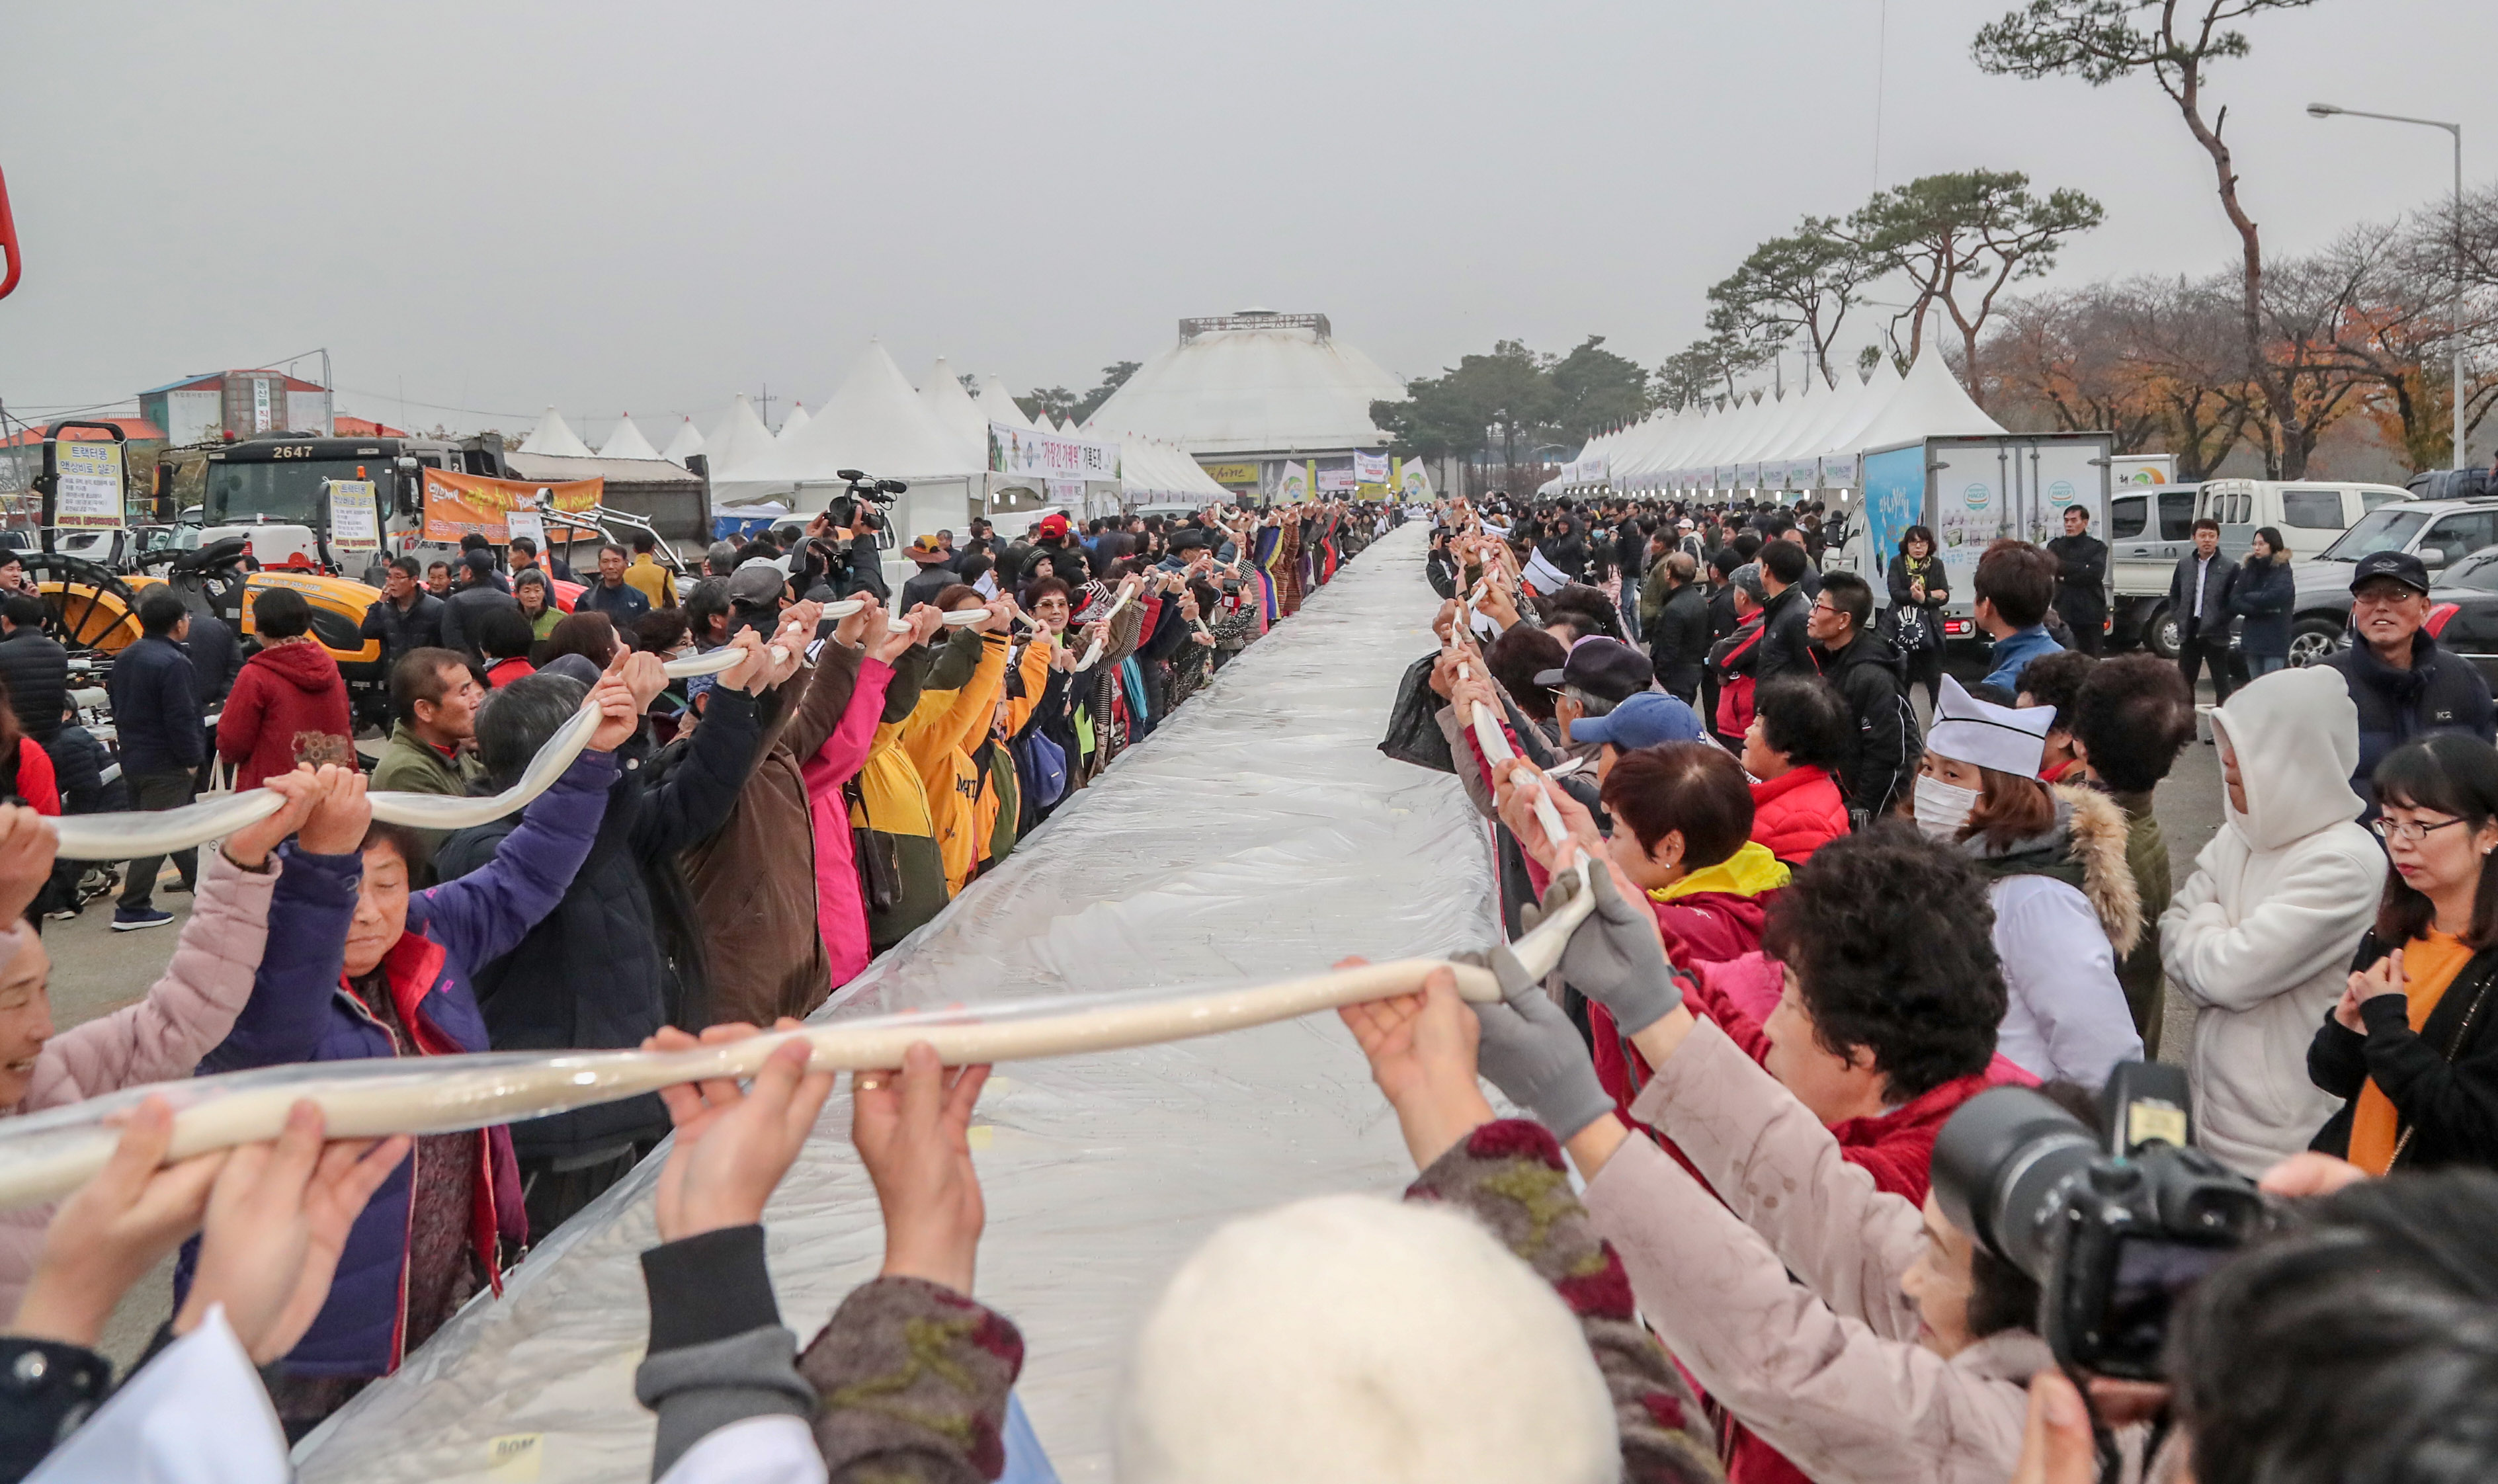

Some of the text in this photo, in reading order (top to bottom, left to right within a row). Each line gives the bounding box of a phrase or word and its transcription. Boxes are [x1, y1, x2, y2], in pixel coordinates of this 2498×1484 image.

[72, 446, 107, 461] 트랙터용
[273, 446, 313, 458] 2647
[1083, 446, 1102, 470] 기록도전
[60, 460, 119, 475] 액상비료 살포기
[453, 464, 460, 472] 2
[341, 484, 366, 495] 트랙터용
[2436, 710, 2452, 720] K2
